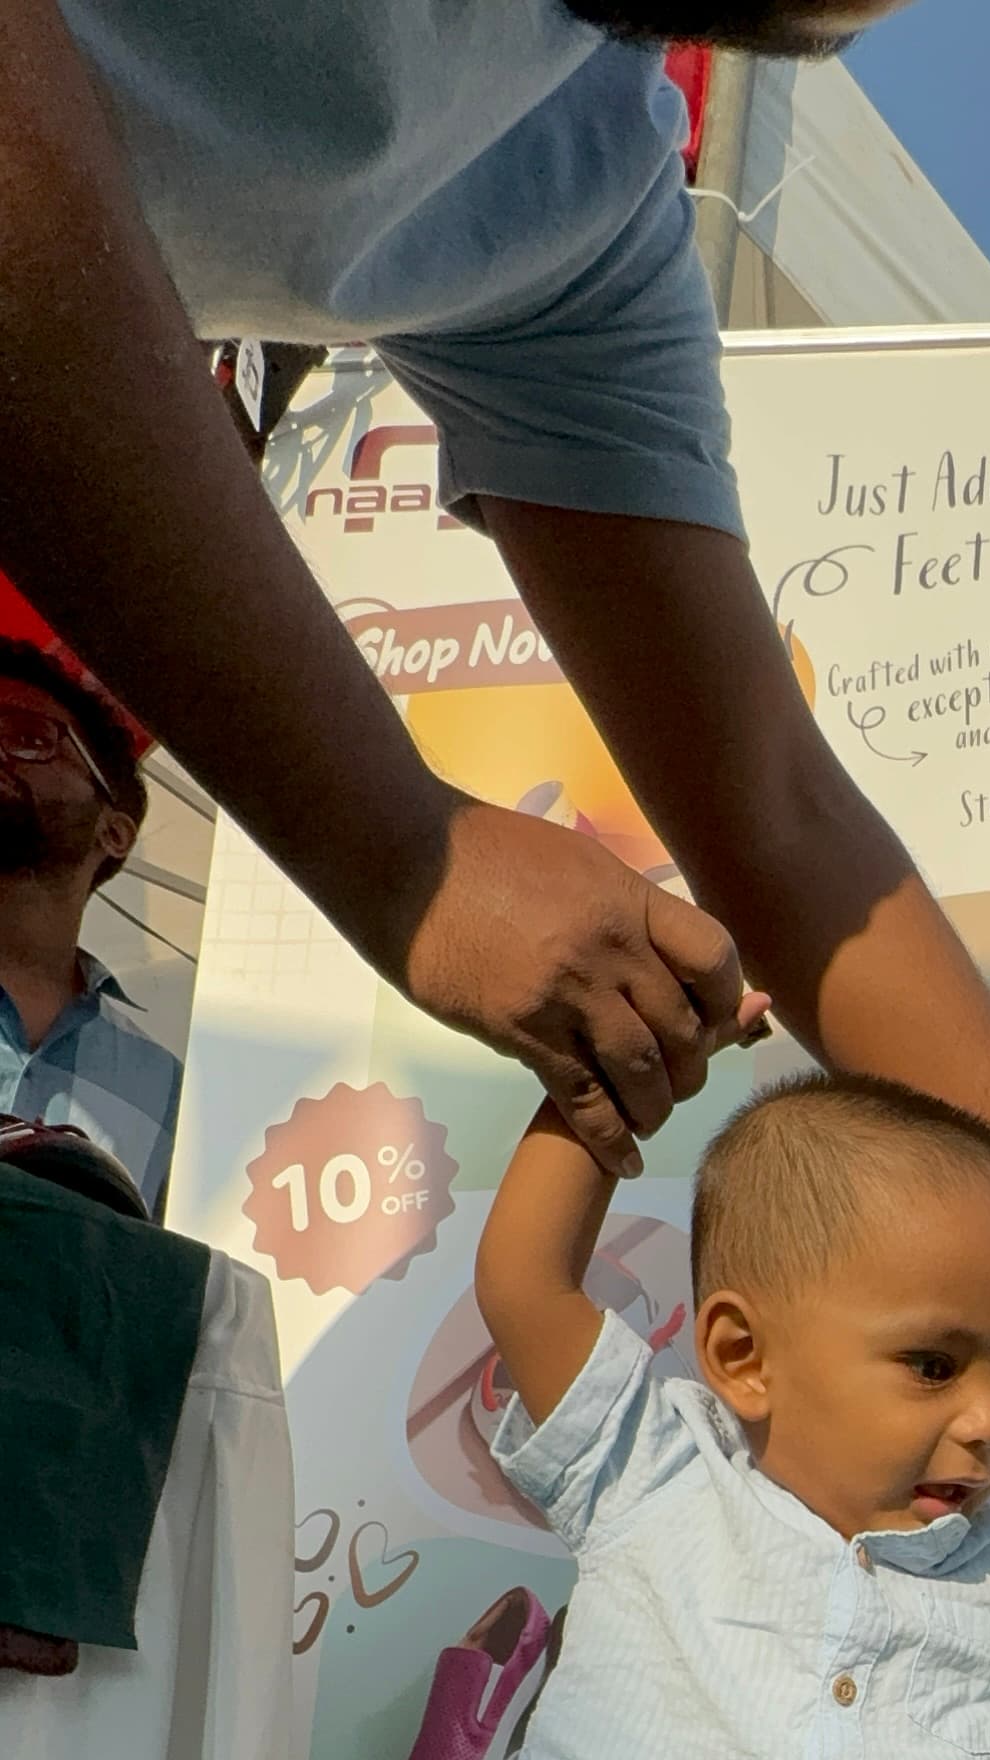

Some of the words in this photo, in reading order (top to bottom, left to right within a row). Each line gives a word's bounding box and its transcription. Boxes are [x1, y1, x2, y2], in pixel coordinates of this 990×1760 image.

[818, 454, 917, 517] Just
[893, 531, 990, 596] Feet
[356, 627, 460, 683] Shop
[828, 653, 920, 697] Crafted
[930, 638, 981, 676] with
[272, 1153, 372, 1232] 10
[381, 1189, 430, 1215] OFF
